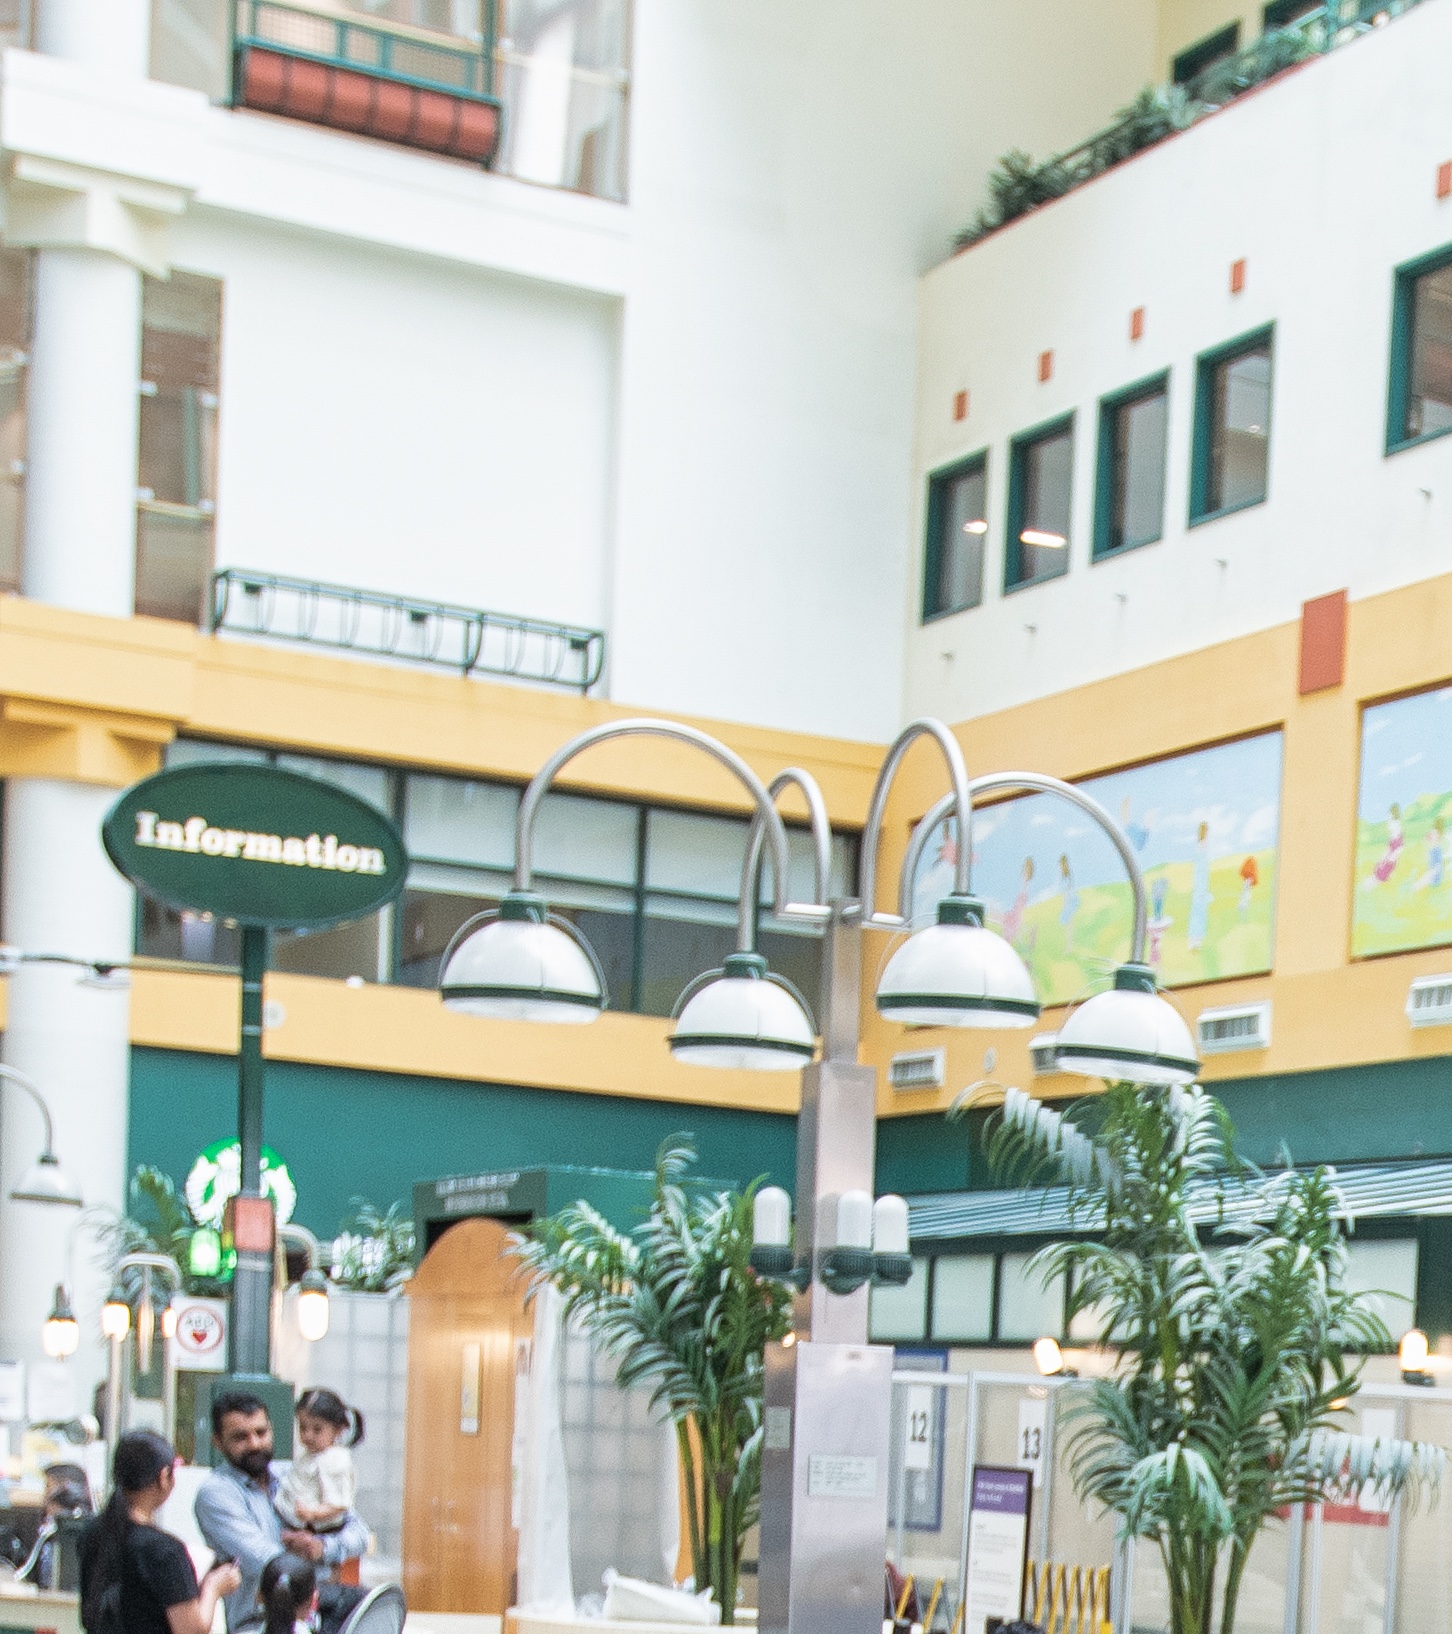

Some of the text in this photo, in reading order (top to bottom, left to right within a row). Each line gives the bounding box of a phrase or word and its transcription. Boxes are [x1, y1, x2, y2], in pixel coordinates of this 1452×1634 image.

[135, 811, 387, 876] Information
[911, 1411, 927, 1443] 12
[1023, 1427, 1041, 1460] 13
